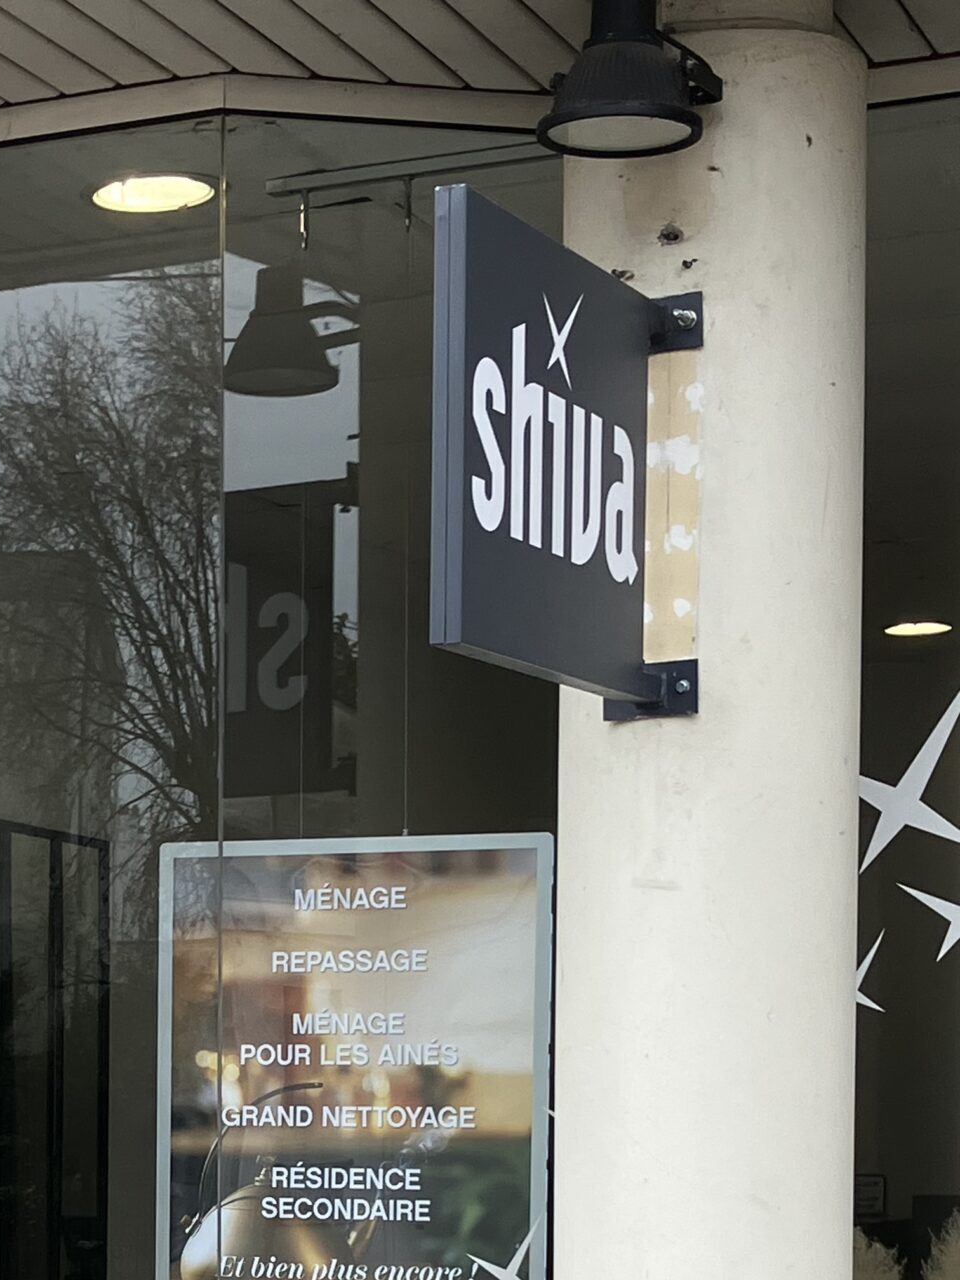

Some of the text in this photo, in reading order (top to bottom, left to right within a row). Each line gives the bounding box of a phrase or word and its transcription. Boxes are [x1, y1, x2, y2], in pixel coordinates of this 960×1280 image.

[471, 323, 639, 586] shiva
[294, 883, 407, 910] MÉNAGE
[271, 949, 429, 974] REPASSAGE
[292, 1008, 406, 1035] MÉNAGE
[240, 1039, 460, 1066] POUR LES AINÉS
[221, 1106, 477, 1130] GRAND NETTOYAGE
[271, 1162, 422, 1191] RÉSIDENCE
[261, 1197, 432, 1223] SECONDAIRE
[220, 1255, 246, 1278] Et
[251, 1256, 305, 1280] bien
